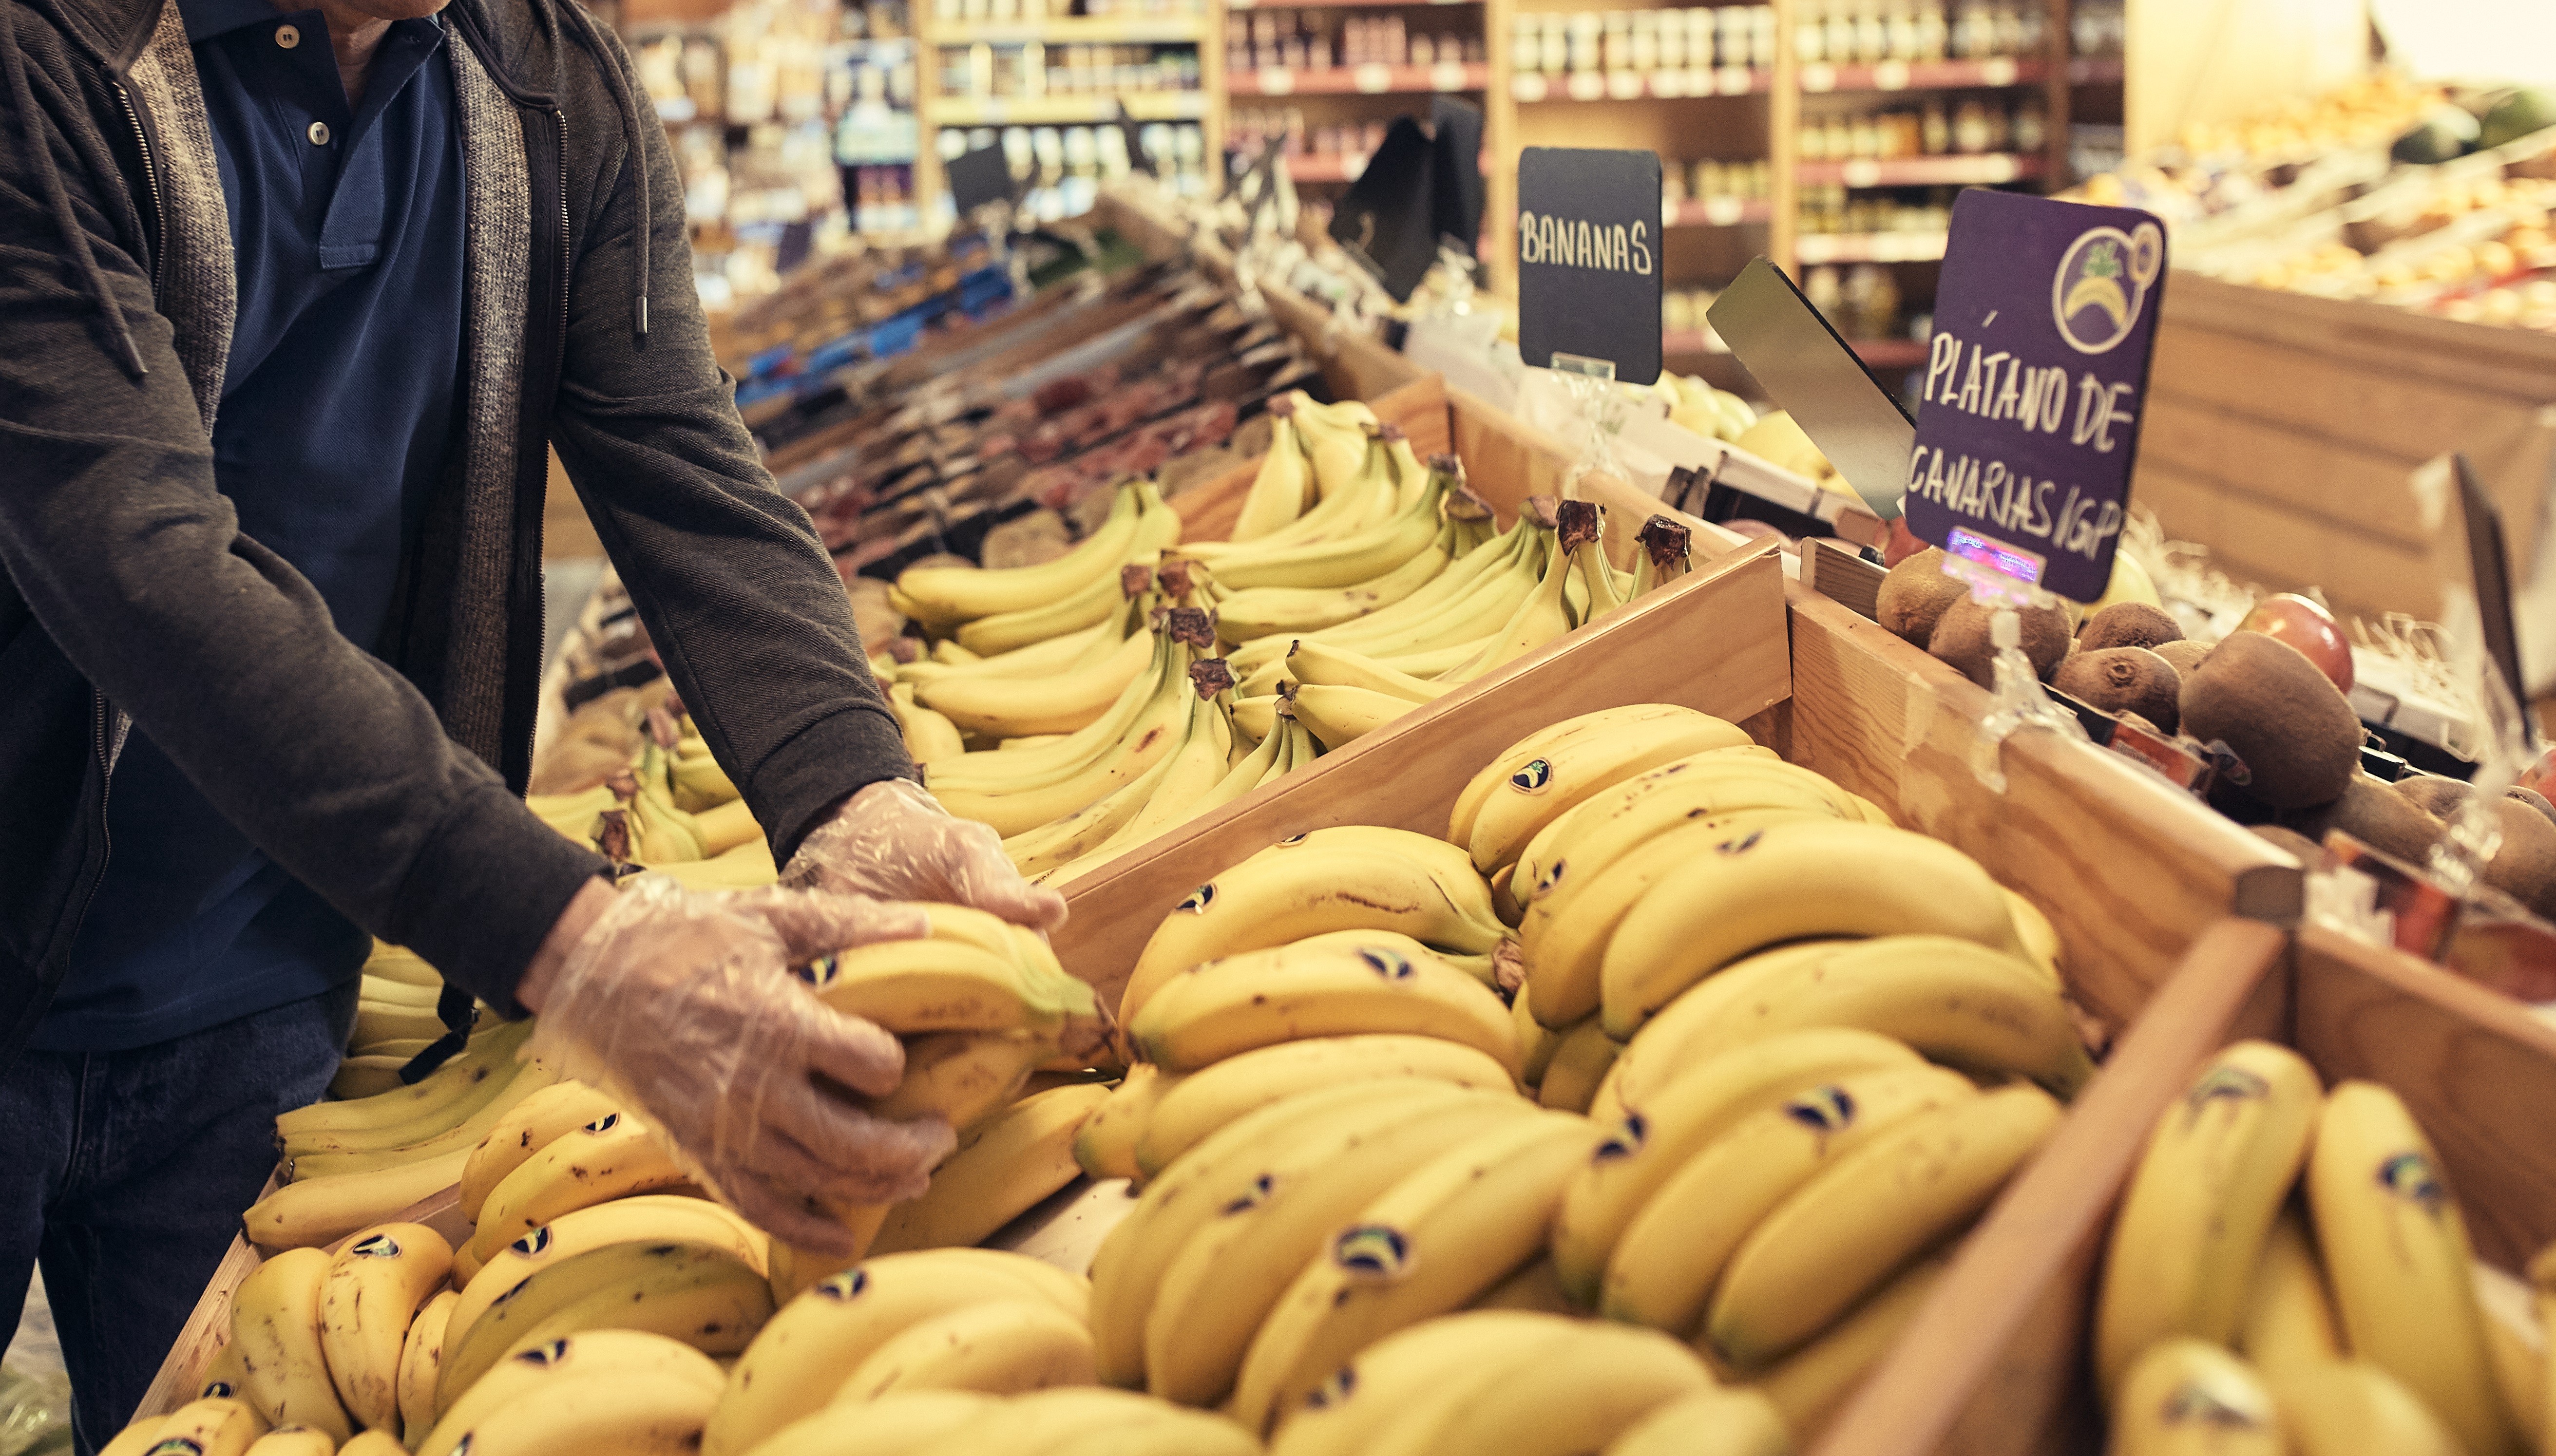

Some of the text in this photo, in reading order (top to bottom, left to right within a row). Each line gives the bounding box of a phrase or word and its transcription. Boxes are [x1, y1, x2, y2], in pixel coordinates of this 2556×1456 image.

[1520, 210, 1652, 275] BANANAS
[1924, 310, 2134, 453] PLÁTANO DE
[1908, 445, 2056, 538] CANARIAS
